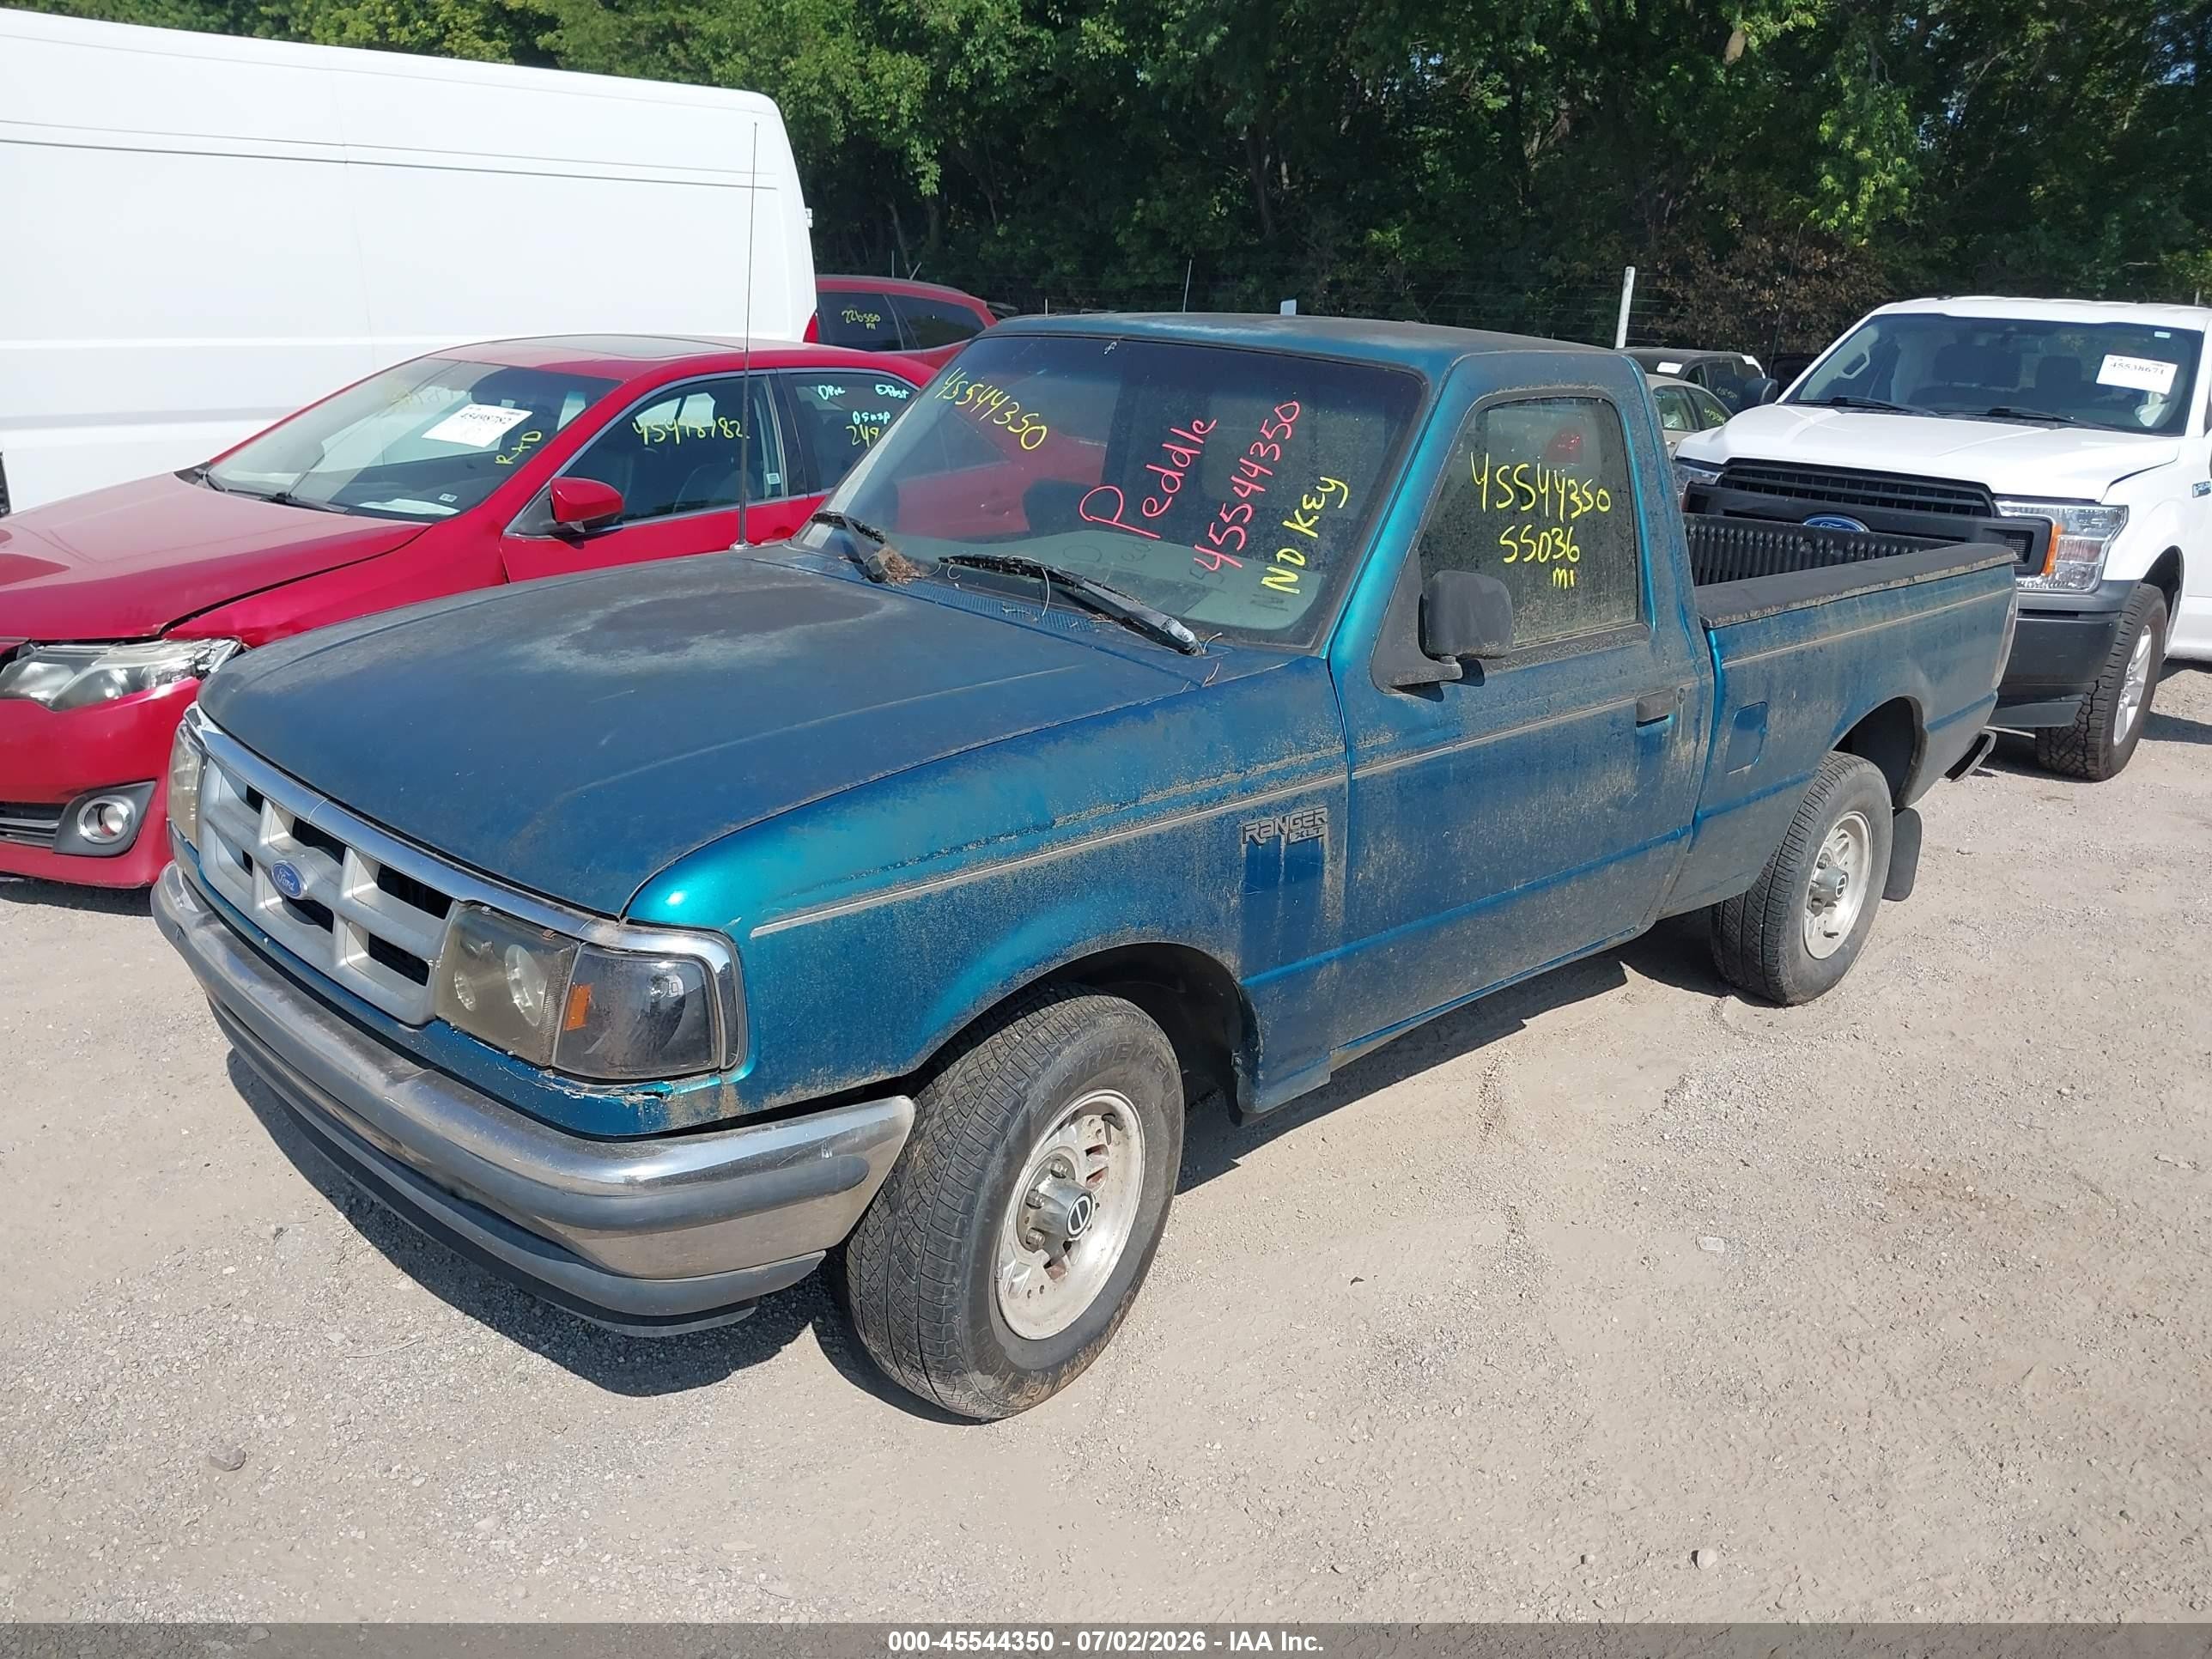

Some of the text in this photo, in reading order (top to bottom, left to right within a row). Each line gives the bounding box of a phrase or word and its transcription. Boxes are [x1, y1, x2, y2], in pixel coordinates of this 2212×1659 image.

[934, 367, 1048, 450] 45544350
[1079, 419, 1217, 539] Peddle
[1194, 400, 1300, 571] 45544350
[1470, 451, 1612, 523] 45544350
[1499, 525, 1580, 563] 55036
[1243, 806, 1328, 846] RANGER
[1295, 825, 1323, 840] XLT
